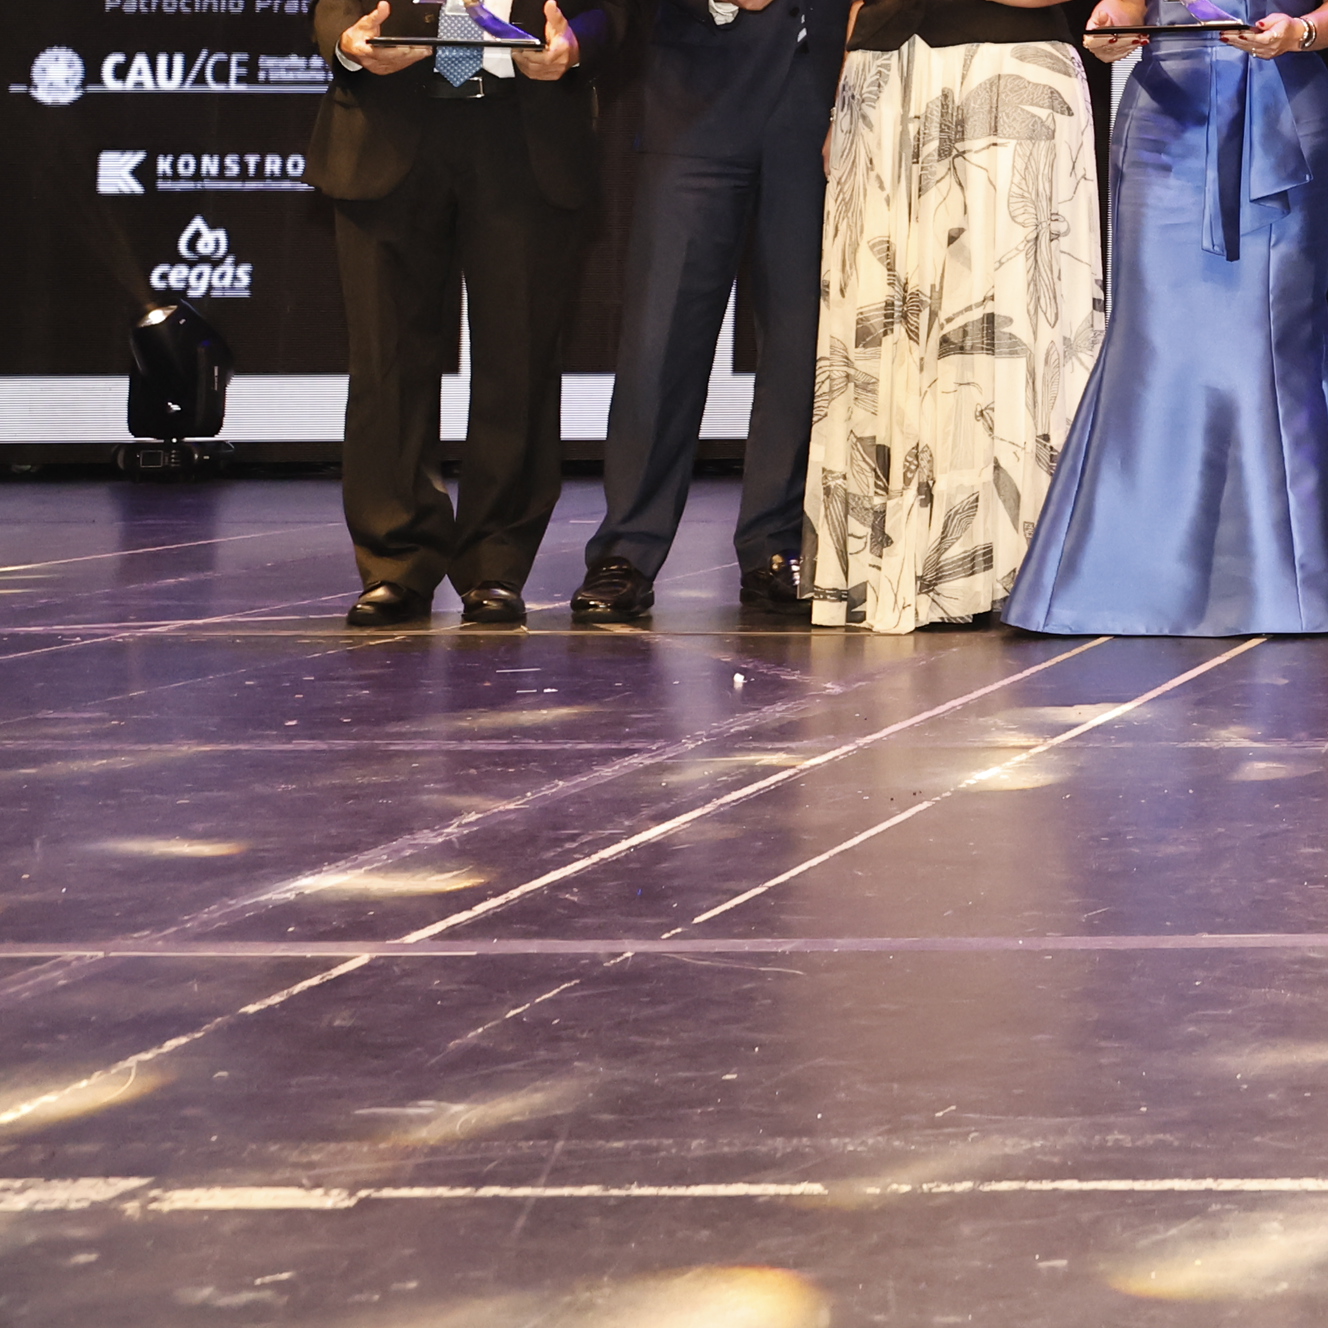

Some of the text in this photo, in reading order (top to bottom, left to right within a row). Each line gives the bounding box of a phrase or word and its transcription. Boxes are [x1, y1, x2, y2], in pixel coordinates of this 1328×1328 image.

[100, 47, 249, 90] CAU/CE
[156, 154, 306, 177] KONSTRO
[149, 253, 254, 299] cegás
